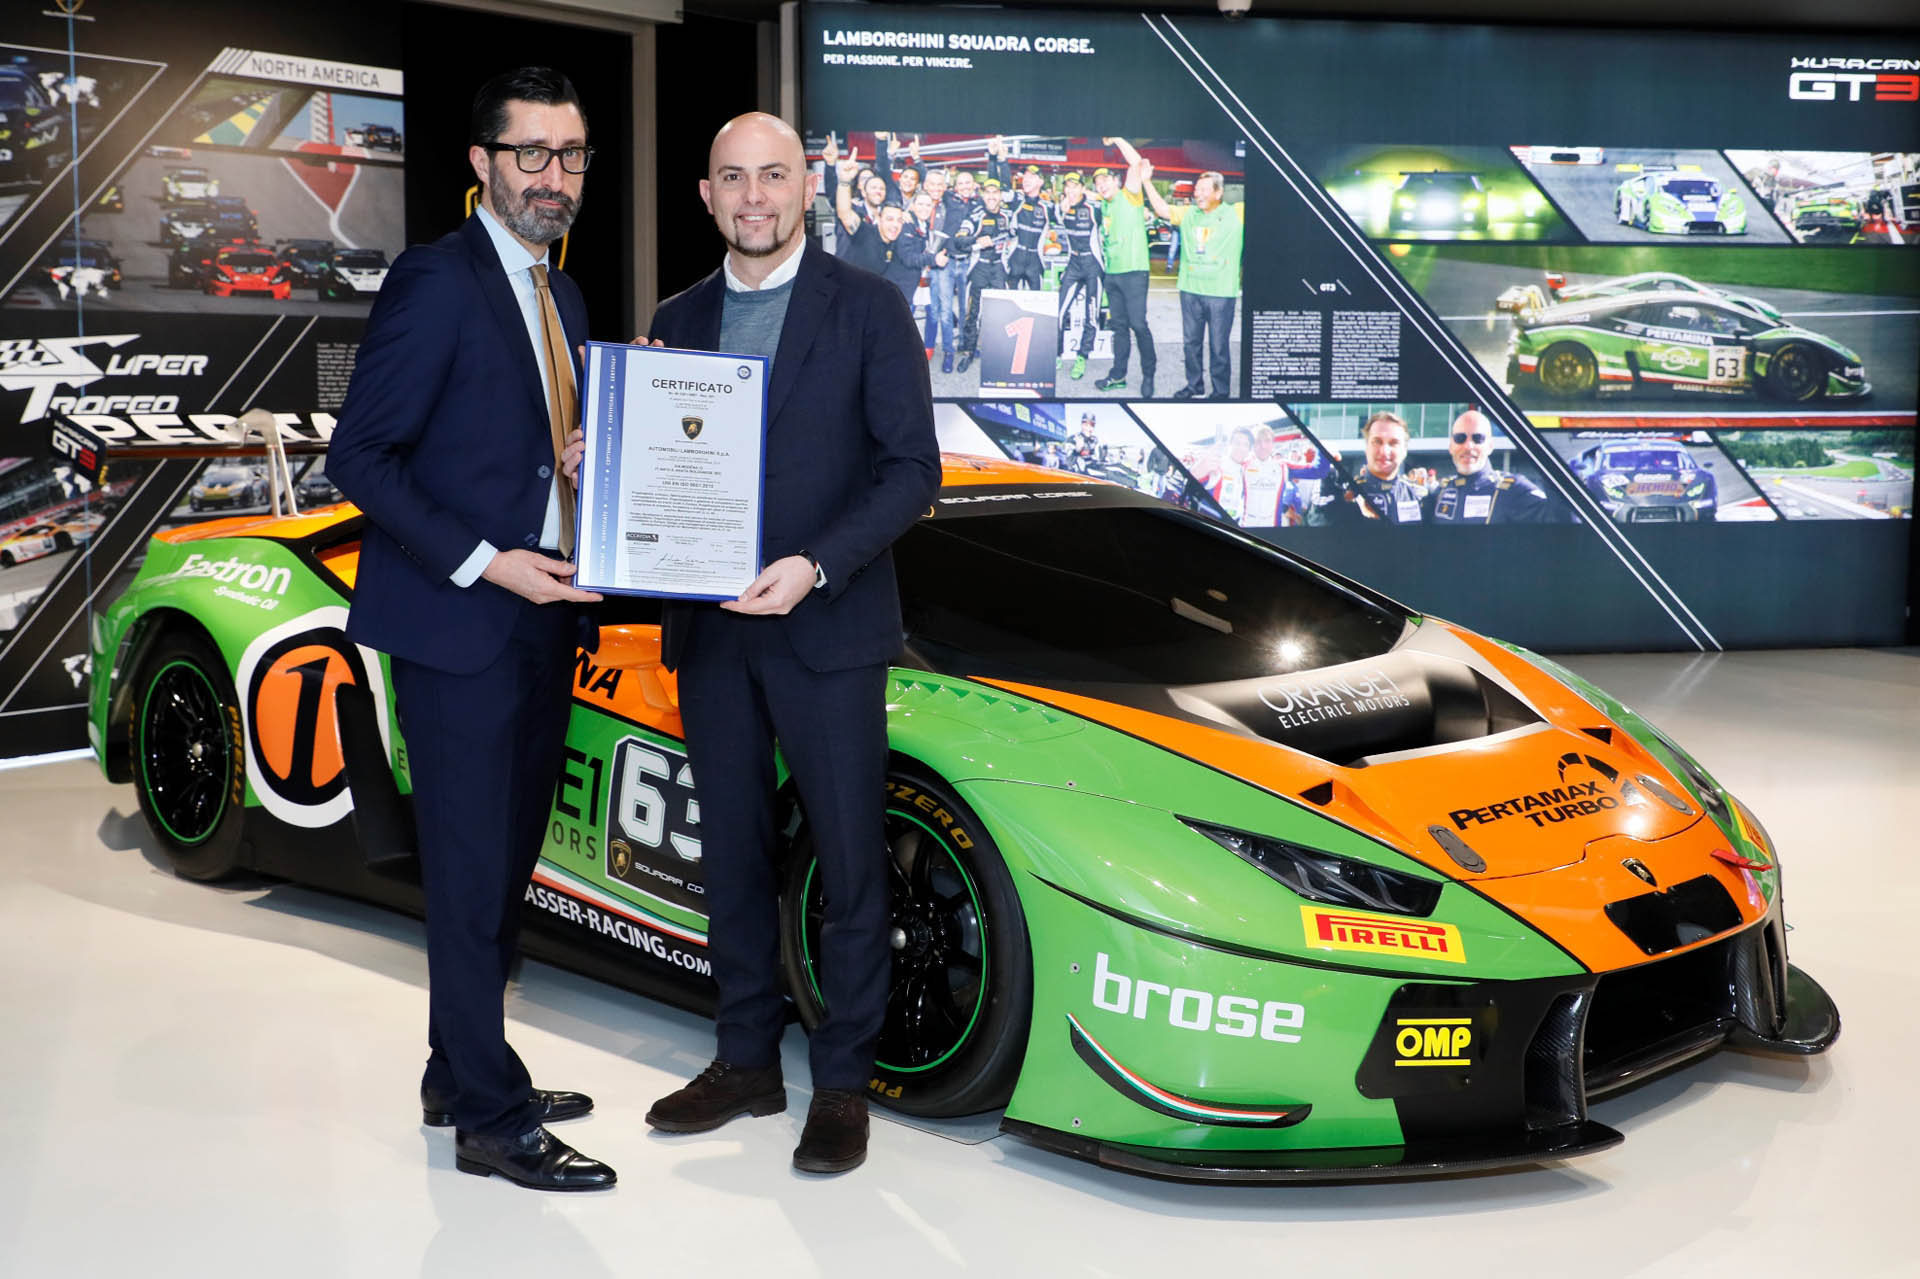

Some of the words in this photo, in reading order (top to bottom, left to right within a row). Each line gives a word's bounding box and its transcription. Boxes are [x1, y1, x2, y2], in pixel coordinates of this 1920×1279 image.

[823, 30, 945, 49] LAMBORGHINI
[948, 34, 1031, 52] SQUADRA
[1034, 37, 1096, 54] CORSE.
[252, 58, 306, 78] NORTH
[312, 66, 380, 88] AMERICA
[823, 54, 845, 64] PER
[847, 54, 901, 66] PASSIONE.
[902, 56, 924, 67] PER
[925, 57, 973, 68] VINCERE.
[1791, 57, 1920, 71] HURACAN
[1789, 72, 1920, 101] GT3
[1320, 283, 1336, 292] GT3
[1004, 316, 1035, 375] 1
[1715, 358, 1740, 378] 63
[651, 378, 733, 394] CERTIFICATO
[52, 429, 97, 471] GT3
[177, 554, 292, 595] Fastron
[1278, 702, 1352, 729] ELECTRIC
[1354, 694, 1411, 713] MOTORS
[1448, 781, 1605, 830] PERTAMAX
[1524, 796, 1620, 827] TURBO
[635, 862, 683, 888] SQUADRA
[1315, 913, 1448, 953] PIRELLI
[1093, 952, 1305, 1043] brose
[1395, 1026, 1472, 1058] OMP
